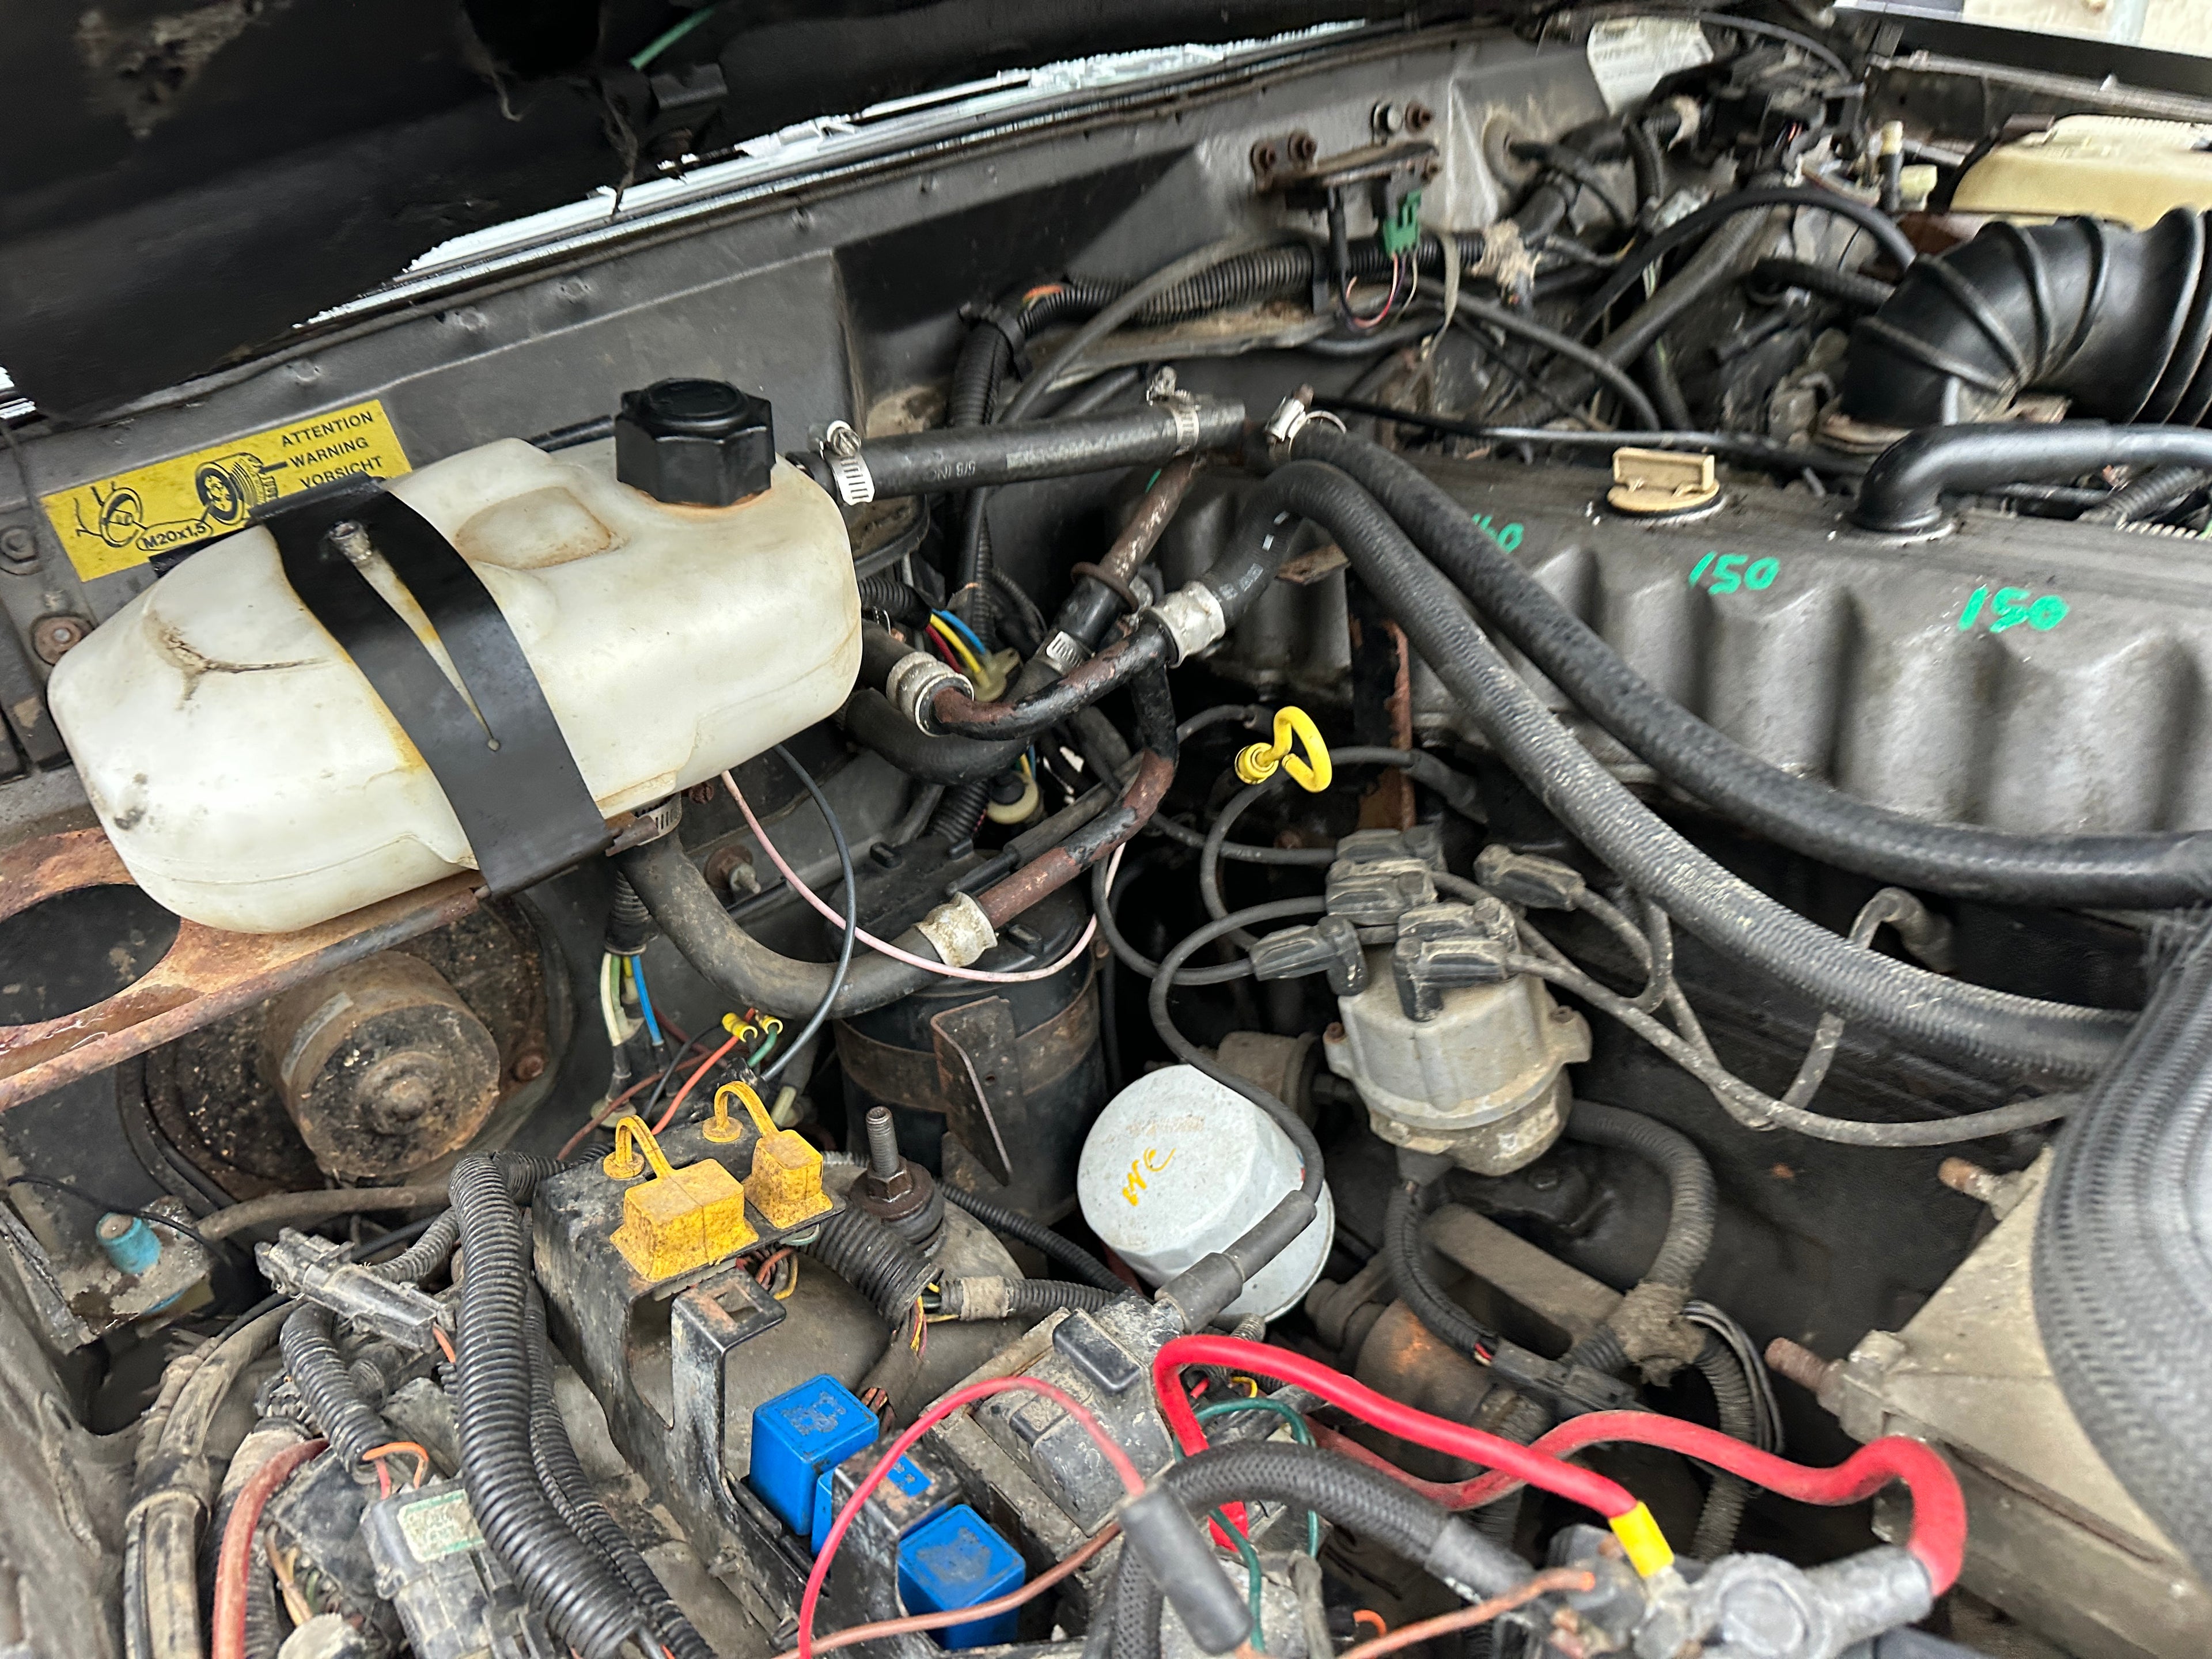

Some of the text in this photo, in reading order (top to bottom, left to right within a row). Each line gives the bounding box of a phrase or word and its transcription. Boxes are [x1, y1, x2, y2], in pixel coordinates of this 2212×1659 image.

[282, 411, 374, 447] ATTENTION
[289, 437, 370, 468] WARNING
[299, 455, 383, 488] VORSICHT
[143, 522, 207, 550] M20x1,5
[1688, 550, 1781, 596] 150
[1959, 585, 2069, 632] 150
